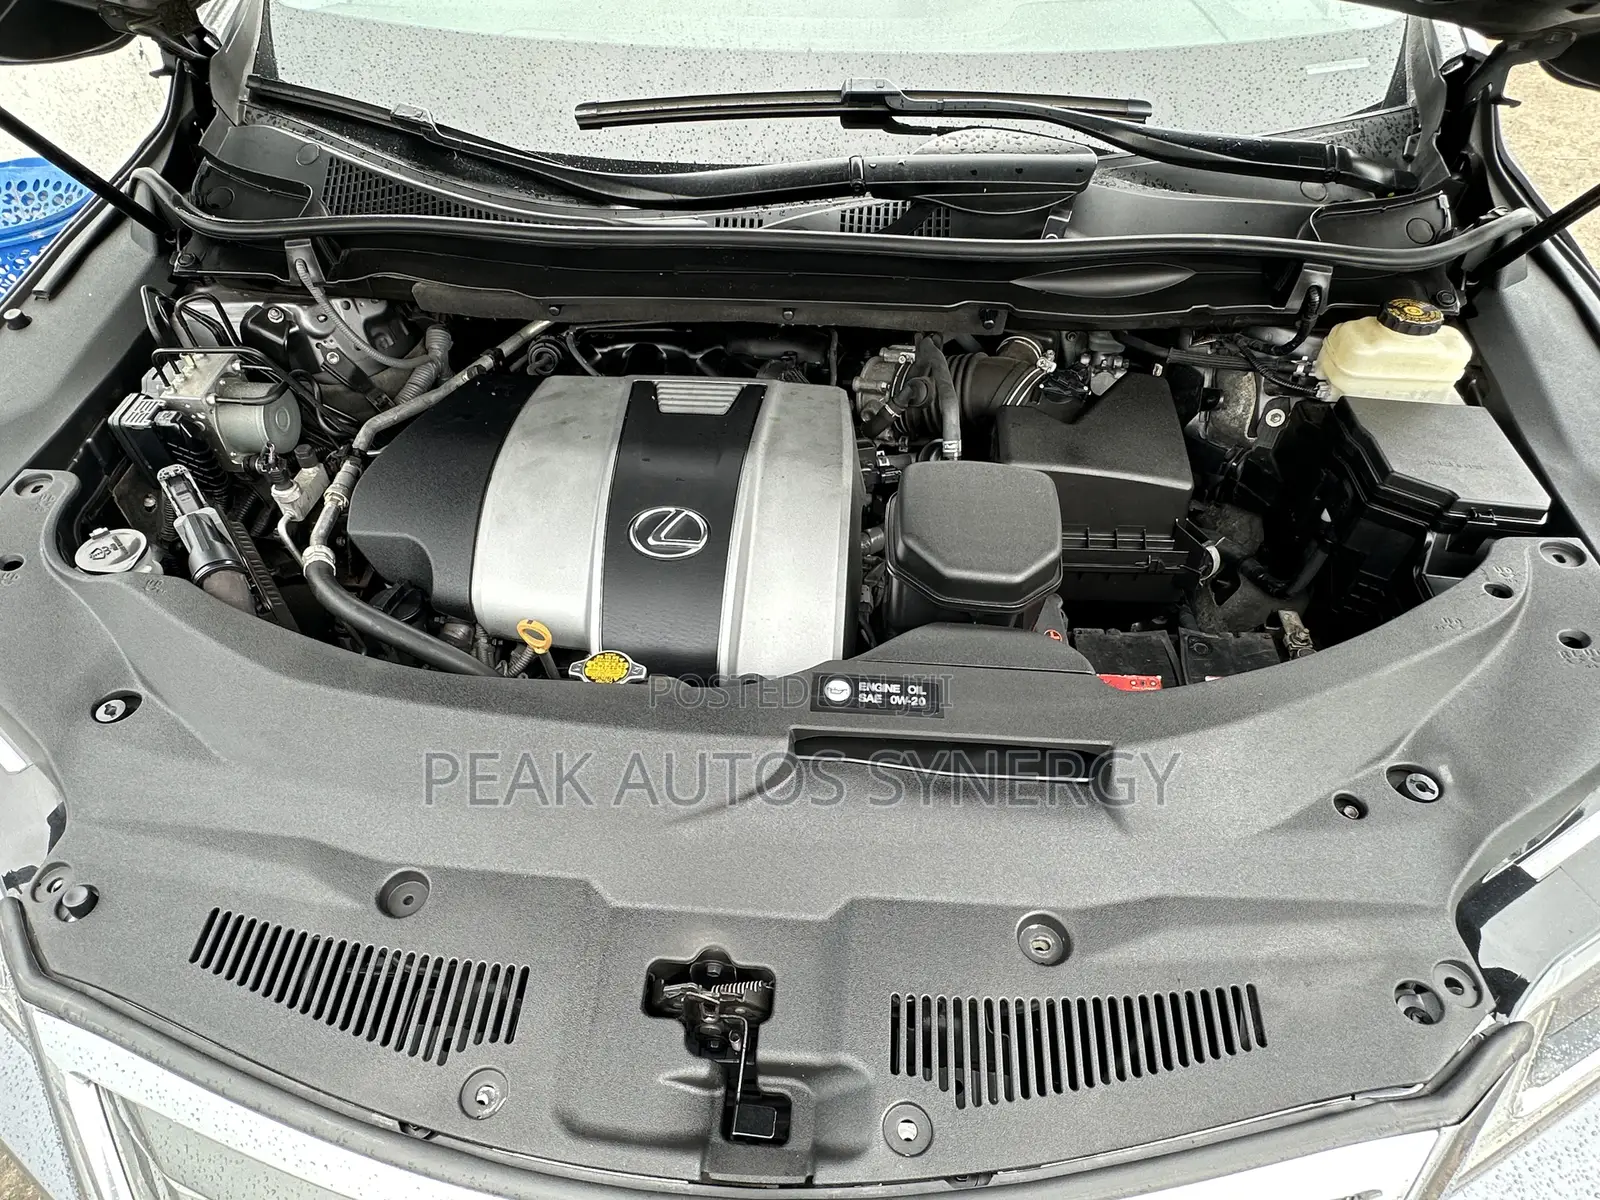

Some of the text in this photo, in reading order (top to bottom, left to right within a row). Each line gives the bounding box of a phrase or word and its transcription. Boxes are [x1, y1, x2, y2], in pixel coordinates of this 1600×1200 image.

[858, 682, 928, 696] ENGINE OIL
[858, 694, 927, 707] SAE 0W-20
